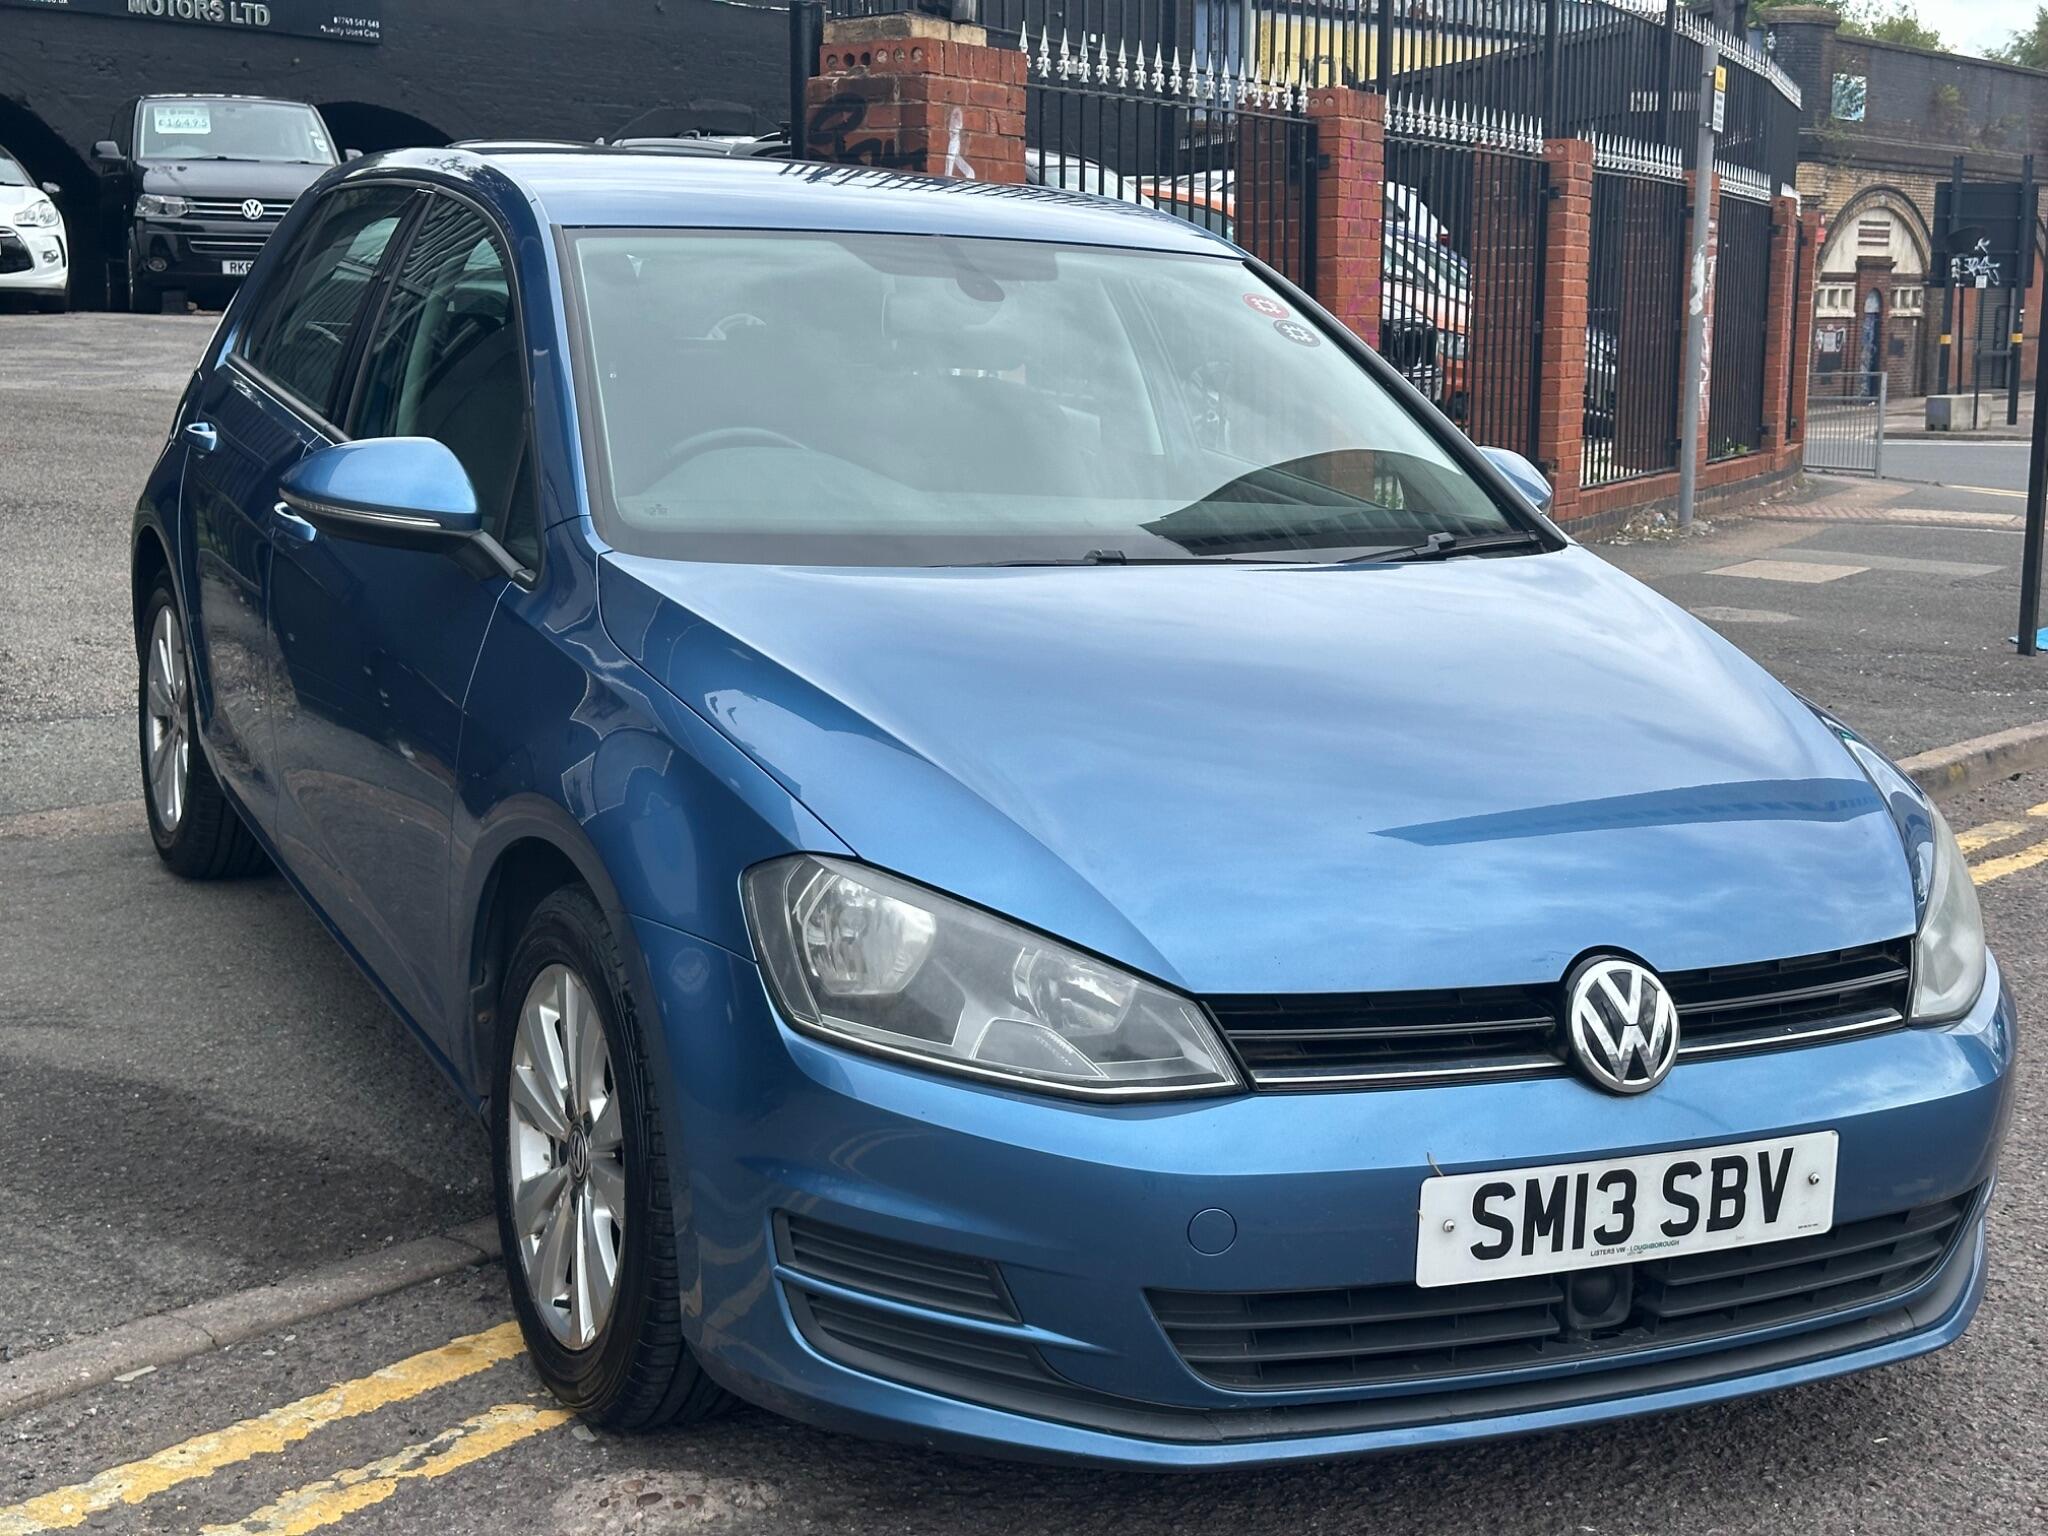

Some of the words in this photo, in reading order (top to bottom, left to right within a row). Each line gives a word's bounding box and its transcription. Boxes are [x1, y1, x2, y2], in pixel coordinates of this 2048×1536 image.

[127, 0, 225, 22] MOTORS
[230, 2, 271, 26] LTD
[345, 28, 363, 37] Used
[363, 28, 380, 39] Cars
[1470, 1169, 1637, 1260] SM13
[1660, 1147, 1794, 1237] SBV
[1590, 1247, 1615, 1256] LISTERS
[1616, 1246, 1626, 1254] VW
[1630, 1240, 1680, 1252] LOUGHBOROUGH
